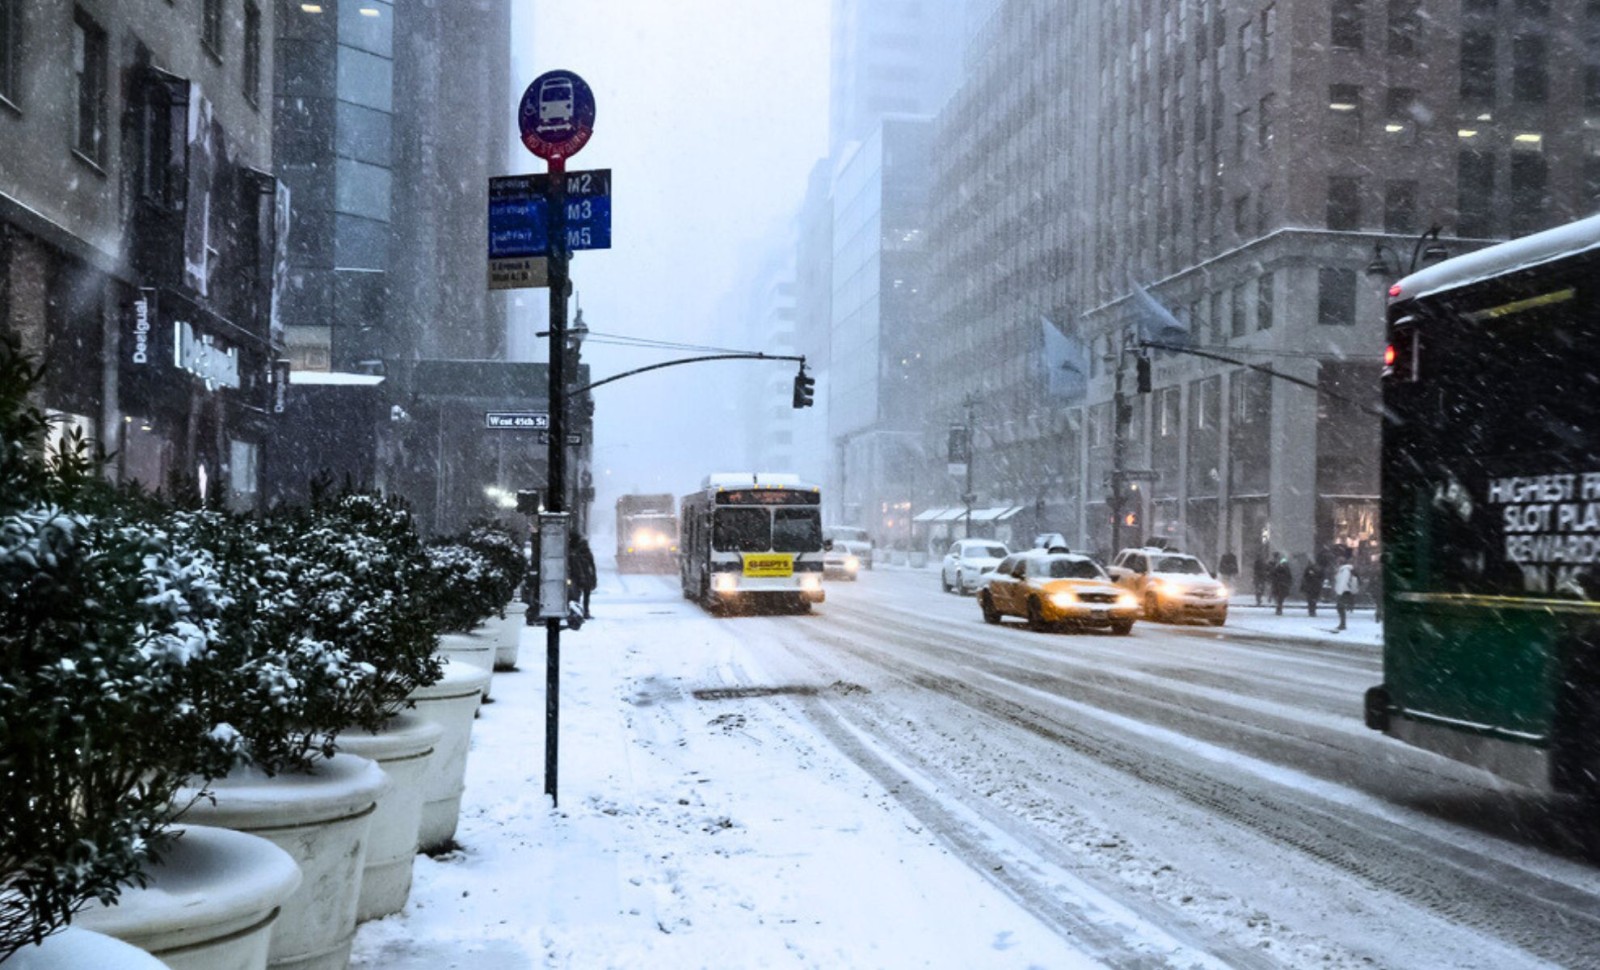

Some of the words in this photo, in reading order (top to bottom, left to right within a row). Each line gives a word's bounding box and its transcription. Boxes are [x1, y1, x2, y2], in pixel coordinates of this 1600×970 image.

[567, 174, 592, 194] M2
[567, 200, 592, 220] M3
[567, 227, 591, 247] M5
[490, 416, 513, 426] West
[514, 417, 535, 426] 45th
[1488, 474, 1576, 502] HIGHEST
[1503, 503, 1554, 532] SLOT
[1558, 502, 1600, 532] PLA
